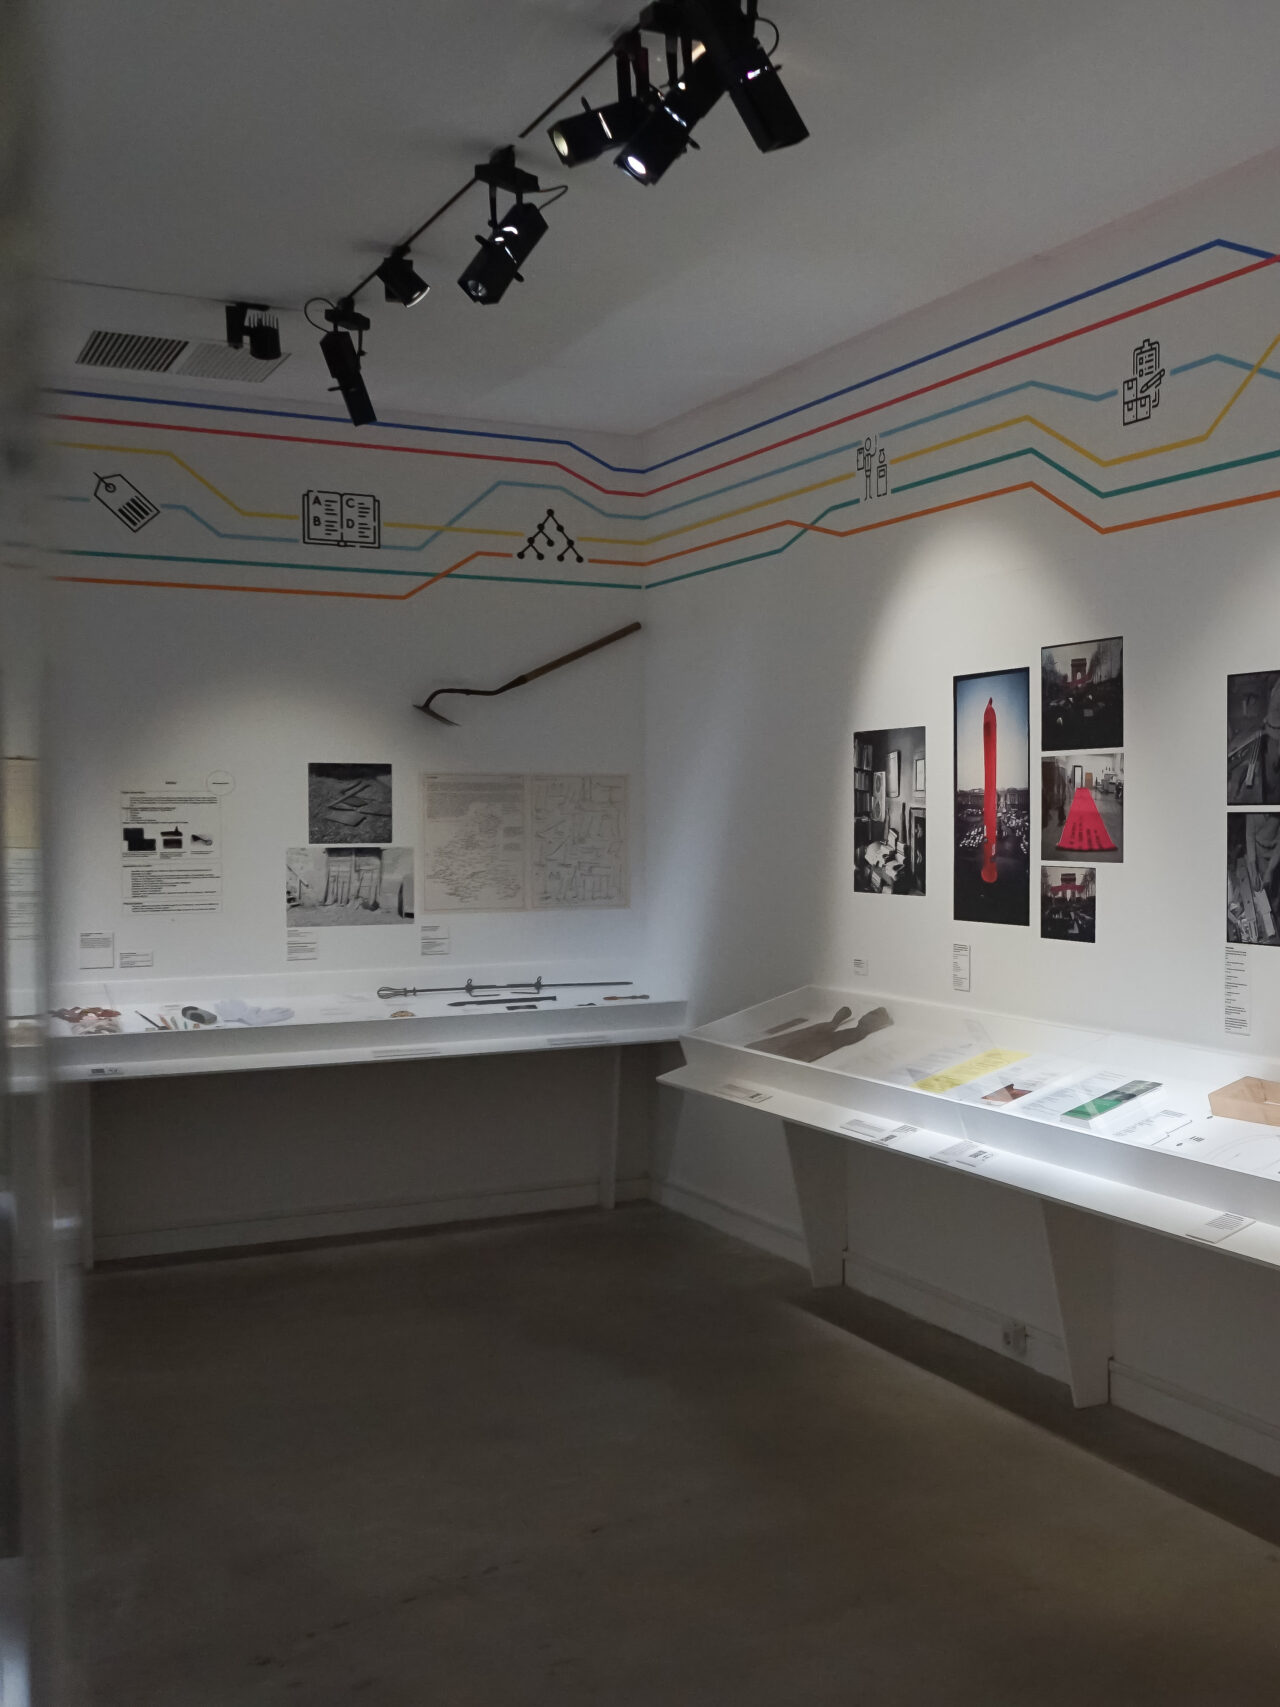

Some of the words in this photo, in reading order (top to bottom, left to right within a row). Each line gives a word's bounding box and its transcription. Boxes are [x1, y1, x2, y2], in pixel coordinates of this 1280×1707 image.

[312, 495, 322, 506] A
[345, 498, 356, 508] C
[313, 516, 321, 526] B
[346, 519, 355, 529] D
